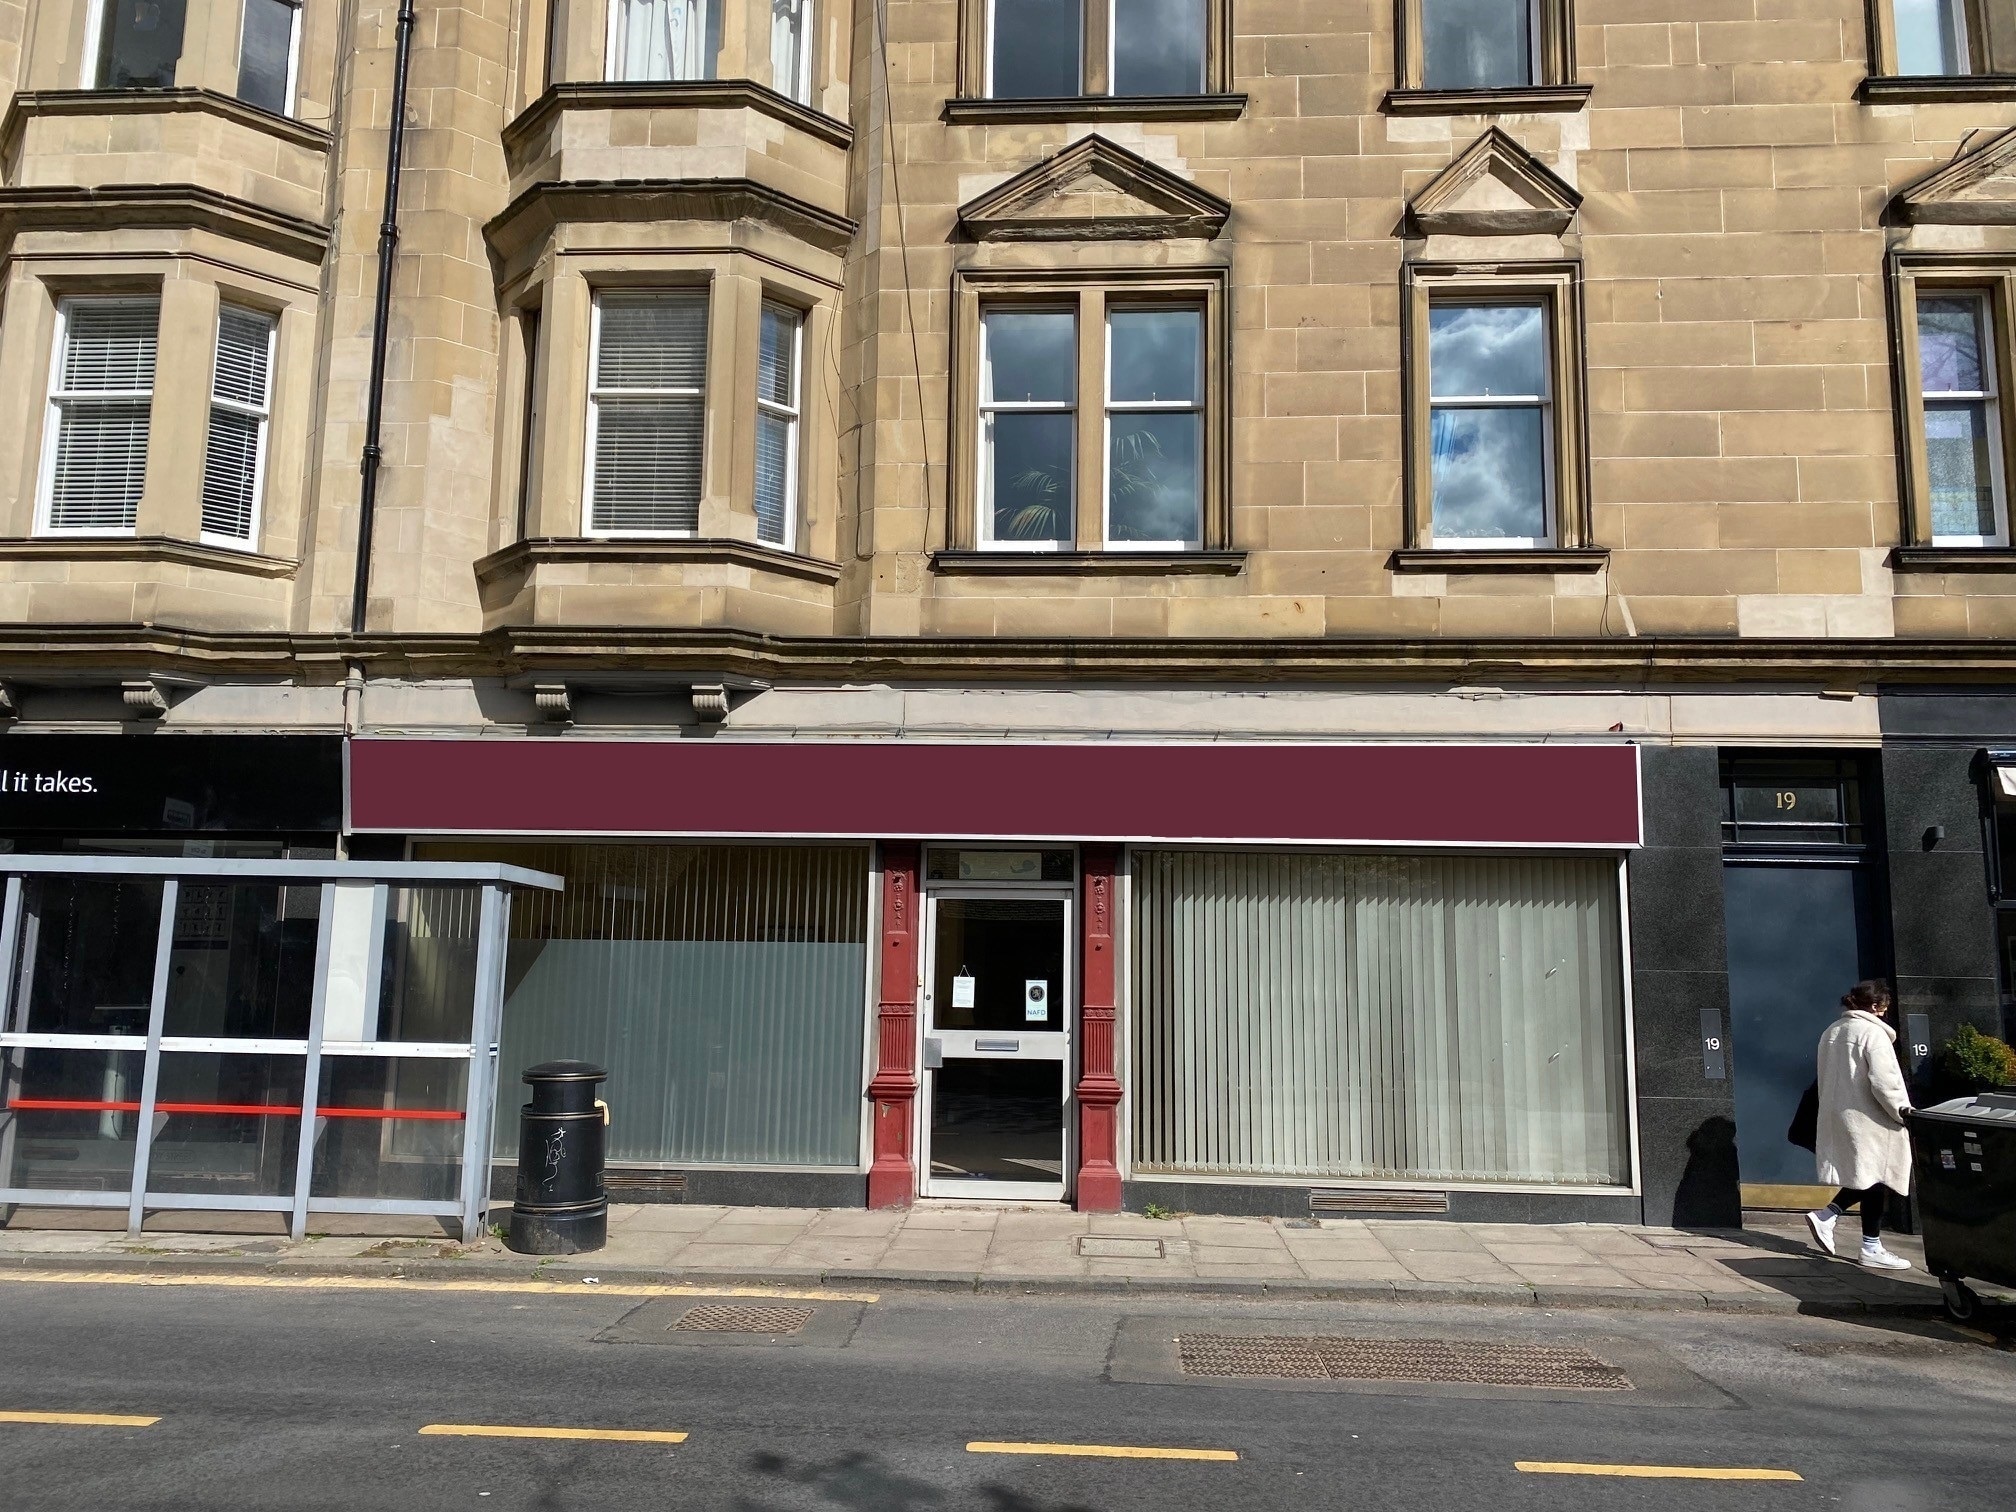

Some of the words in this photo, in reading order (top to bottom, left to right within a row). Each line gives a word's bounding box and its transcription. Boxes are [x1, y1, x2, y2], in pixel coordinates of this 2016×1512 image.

[0, 769, 8, 793] l
[13, 771, 29, 793] it
[34, 769, 98, 793] takes.
[1776, 791, 1797, 810] 19
[1705, 1037, 1720, 1050] 19
[1912, 1043, 1928, 1056] 19
